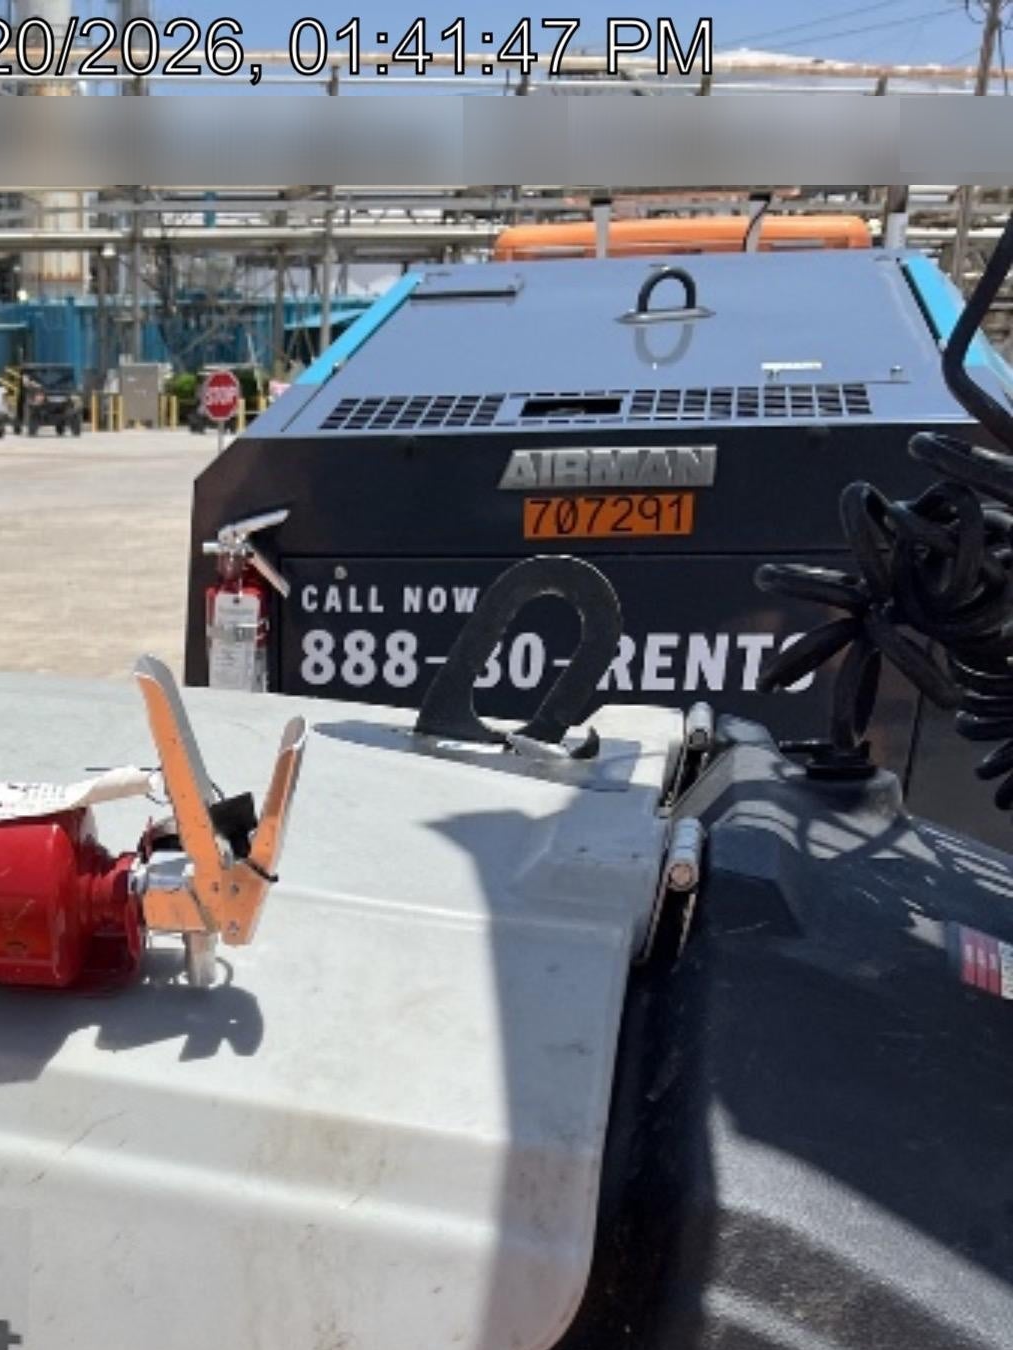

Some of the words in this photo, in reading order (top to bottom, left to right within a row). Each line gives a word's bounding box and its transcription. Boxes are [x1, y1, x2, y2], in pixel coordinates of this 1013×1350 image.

[205, 386, 237, 406] STOP
[497, 444, 717, 489] AIRMAN
[529, 495, 685, 535] 707291
[301, 584, 384, 613] CALL
[402, 586, 481, 613] NOW
